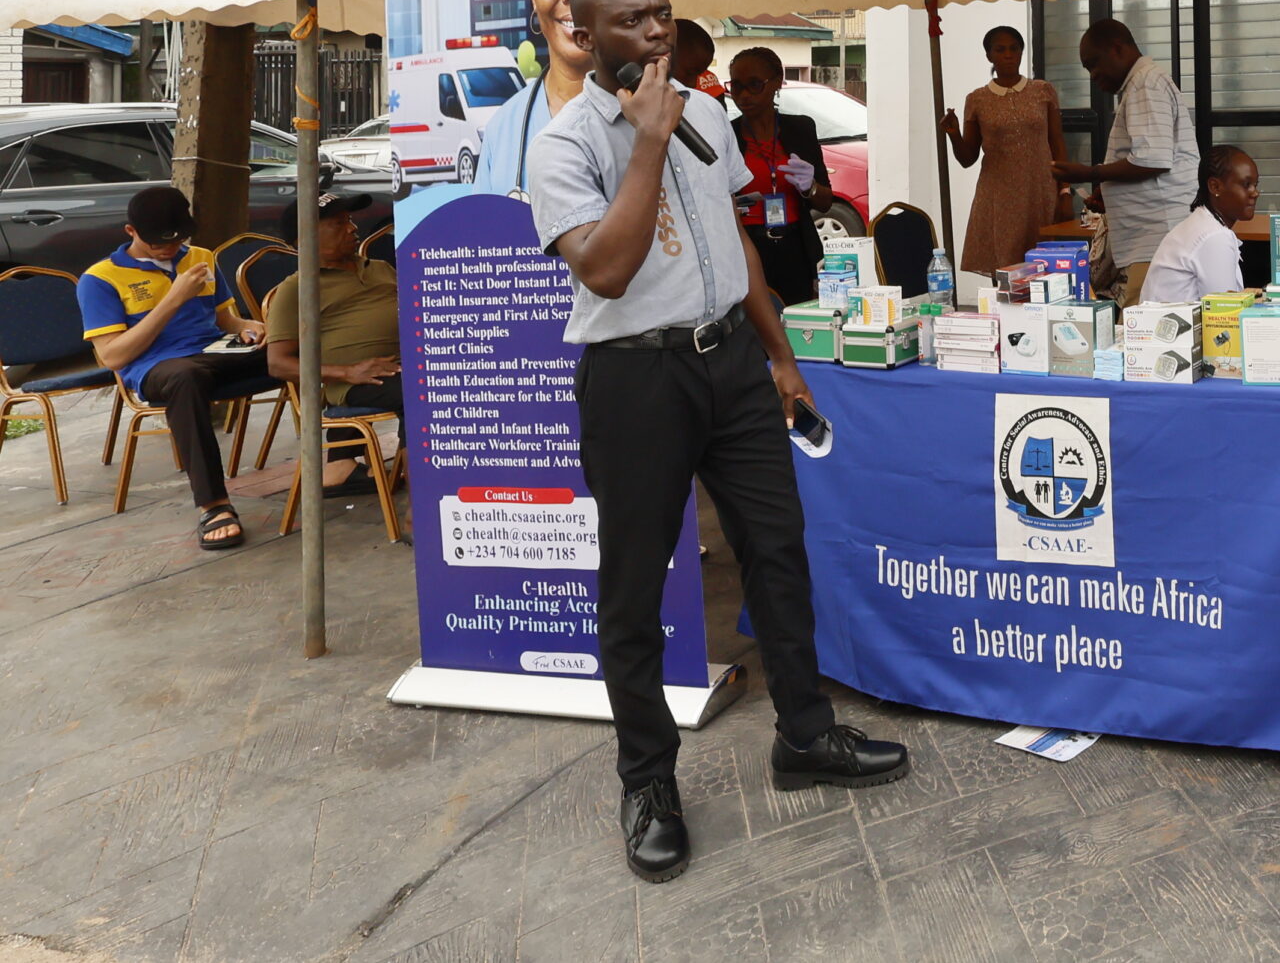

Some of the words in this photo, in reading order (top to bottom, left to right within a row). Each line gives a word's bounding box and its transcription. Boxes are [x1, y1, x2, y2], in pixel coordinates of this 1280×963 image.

[419, 247, 475, 260] Telehealth:
[478, 246, 513, 258] instant
[515, 245, 544, 256] acces
[424, 263, 460, 276] mental
[462, 261, 493, 274] health
[495, 259, 557, 276] professional
[420, 279, 442, 292] Test
[444, 279, 457, 291] It:
[460, 278, 484, 290] Next
[486, 277, 512, 289] Door
[514, 276, 550, 288] Instant
[422, 295, 456, 308] Health
[459, 293, 509, 307] Insurance
[423, 311, 479, 325] Emergency
[482, 310, 501, 322] and
[504, 309, 528, 321] First
[530, 308, 549, 320] Aid
[423, 327, 465, 340] Medical
[467, 326, 510, 341] Supplies
[424, 343, 456, 355] Smart
[459, 342, 494, 354] Clinics
[425, 358, 497, 371] Immunization
[499, 358, 518, 370] and
[521, 357, 576, 370] Preventive
[426, 375, 460, 387] Health
[463, 374, 515, 386] Education
[517, 374, 536, 386] and
[539, 373, 575, 386] Promo
[427, 391, 458, 403] Home
[460, 390, 515, 402] Healthcare
[518, 390, 533, 402] for
[535, 390, 551, 402] the
[432, 407, 451, 419] and
[454, 407, 500, 419] Children
[429, 423, 477, 435] Maternal
[479, 423, 498, 435] and
[501, 423, 532, 435] Infant
[534, 423, 570, 435] Health
[1009, 418, 1027, 438] Social
[431, 439, 487, 451] Healthcare
[489, 438, 542, 451] Workforce
[431, 454, 469, 469] Quality
[471, 455, 528, 467] Assessment
[530, 455, 550, 468] and
[553, 455, 581, 468] Advo
[484, 489, 520, 501] Contact
[522, 491, 533, 502] Us
[464, 509, 586, 527] chealth.csaaeinc.org
[466, 527, 597, 546] chealth@csaaeinc.org
[467, 546, 496, 559] +234
[500, 546, 520, 559] 704
[523, 546, 543, 560] 600
[547, 547, 576, 560] 7185
[522, 580, 588, 597] C-Health
[875, 544, 979, 599] Together
[986, 571, 1021, 601] we
[1026, 574, 1070, 606] can
[1080, 571, 1145, 615] make
[1152, 576, 1223, 630] Africa
[474, 594, 560, 616] Enhancing
[446, 613, 504, 634] Quality
[509, 616, 577, 637] Primary
[952, 624, 965, 655] a
[974, 618, 1047, 663] better
[1055, 624, 1123, 673] place
[553, 657, 586, 669] CSAAE
